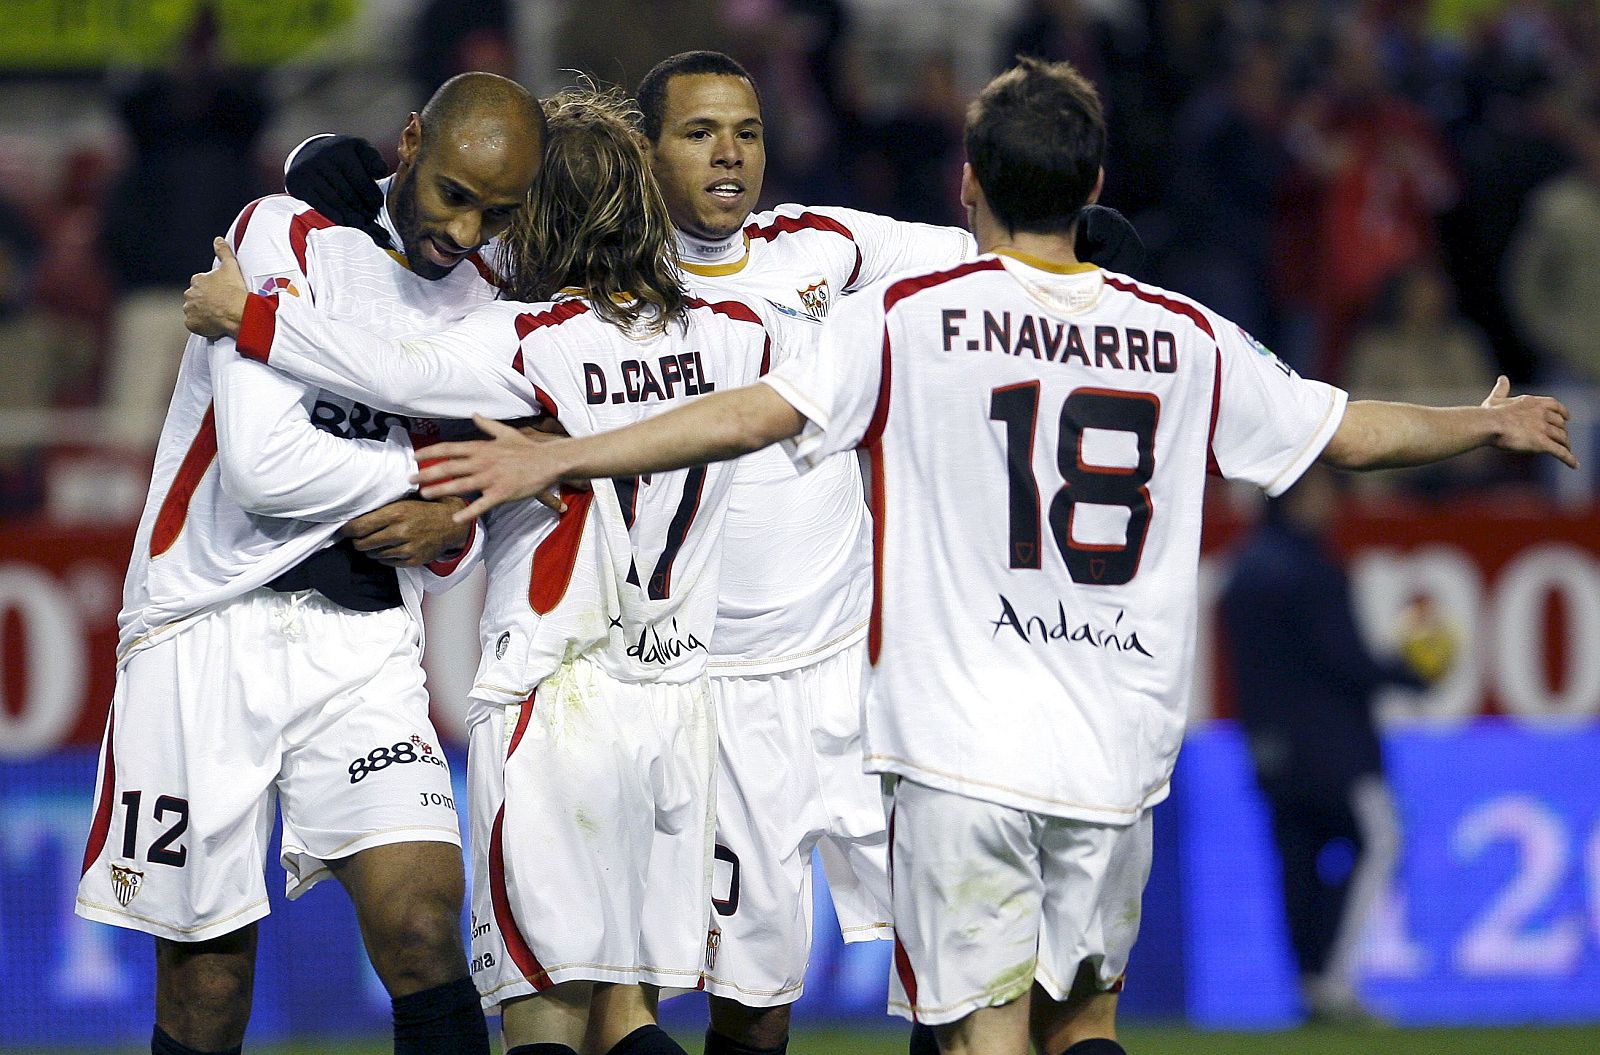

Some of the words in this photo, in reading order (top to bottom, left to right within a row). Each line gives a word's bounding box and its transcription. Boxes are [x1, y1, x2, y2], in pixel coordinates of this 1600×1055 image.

[575, 350, 715, 405] D.CAPEL
[940, 308, 1178, 375] F.NAVARRO
[989, 379, 1162, 586] 18
[120, 790, 190, 868] 12
